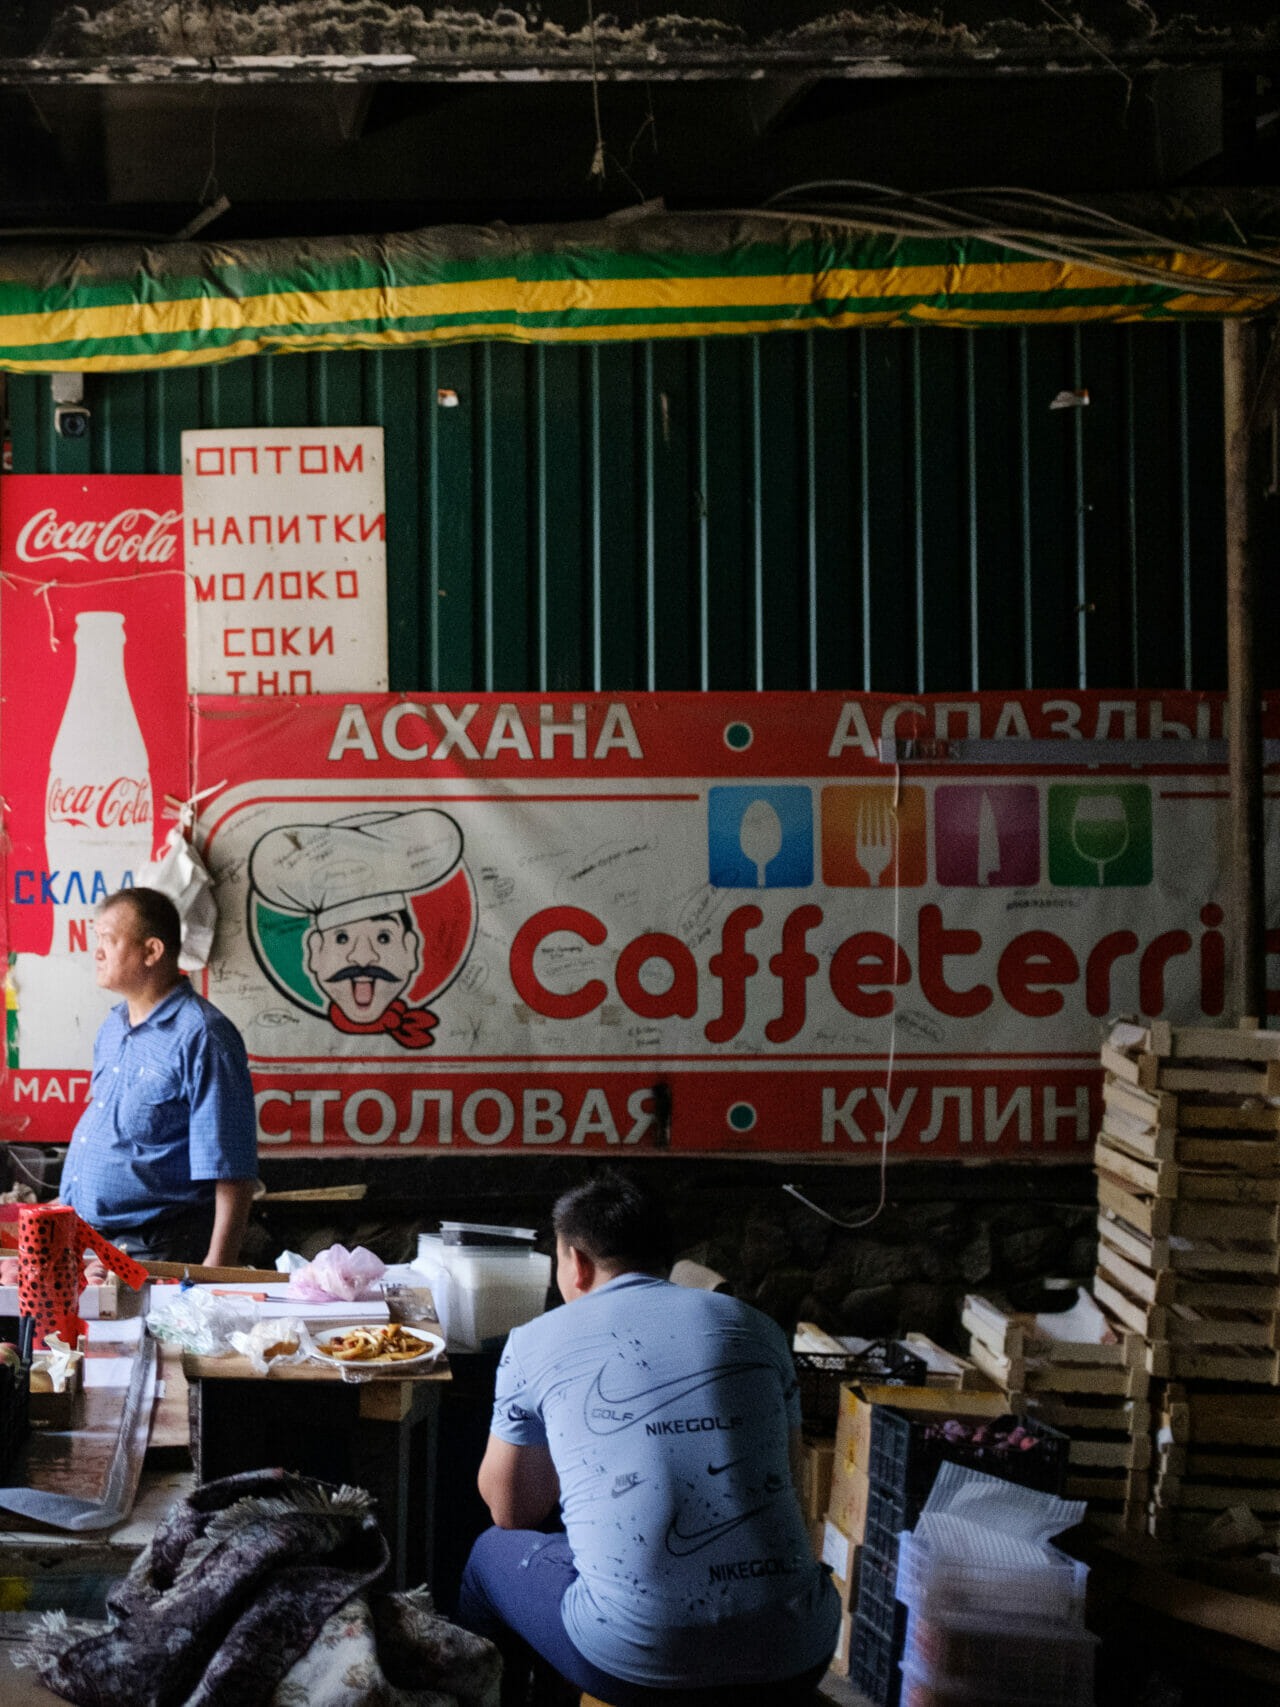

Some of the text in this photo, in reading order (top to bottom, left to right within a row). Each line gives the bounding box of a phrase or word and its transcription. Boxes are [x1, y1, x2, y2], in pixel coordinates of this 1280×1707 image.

[196, 444, 363, 476] ОПТОМ
[16, 508, 186, 563] Coca-Cola
[193, 513, 387, 546] НАПИТКИ
[193, 570, 359, 602] МОЛОКО
[223, 626, 334, 658] СОКИ
[327, 702, 645, 762] АСХАНА
[48, 777, 153, 829] Coca-Cola
[509, 903, 1280, 1044] Caffeterri
[256, 1086, 1090, 1145] СТОЛОВАЯ КУЛИН
[645, 1416, 744, 1437] NIKEGOLF
